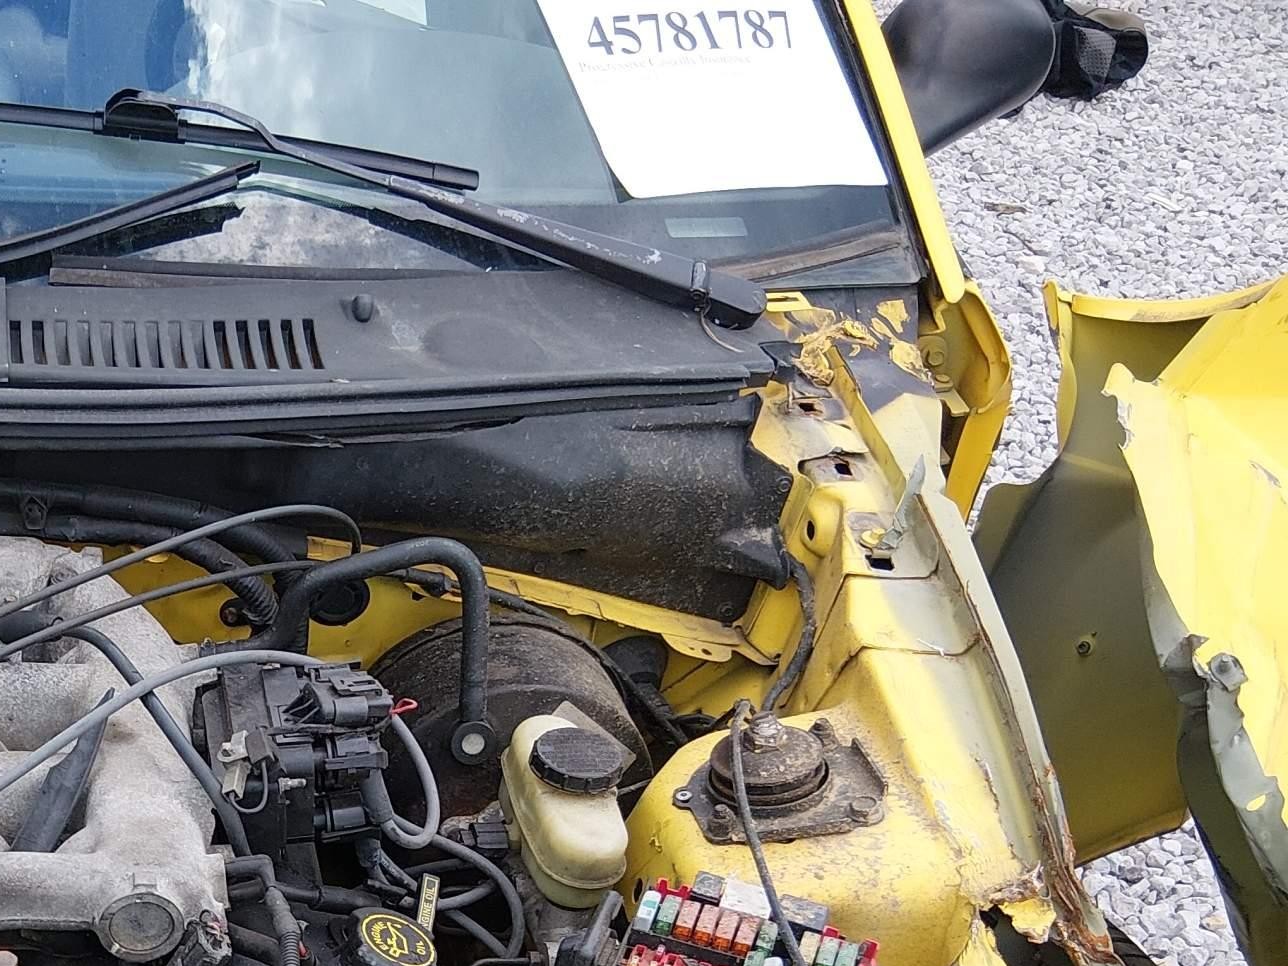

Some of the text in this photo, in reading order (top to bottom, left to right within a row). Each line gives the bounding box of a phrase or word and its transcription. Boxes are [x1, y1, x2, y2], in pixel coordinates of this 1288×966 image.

[587, 9, 792, 55] 45781787
[425, 887, 435, 900] OIL
[371, 921, 390, 951] ENGINE
[415, 940, 426, 955] OIL
